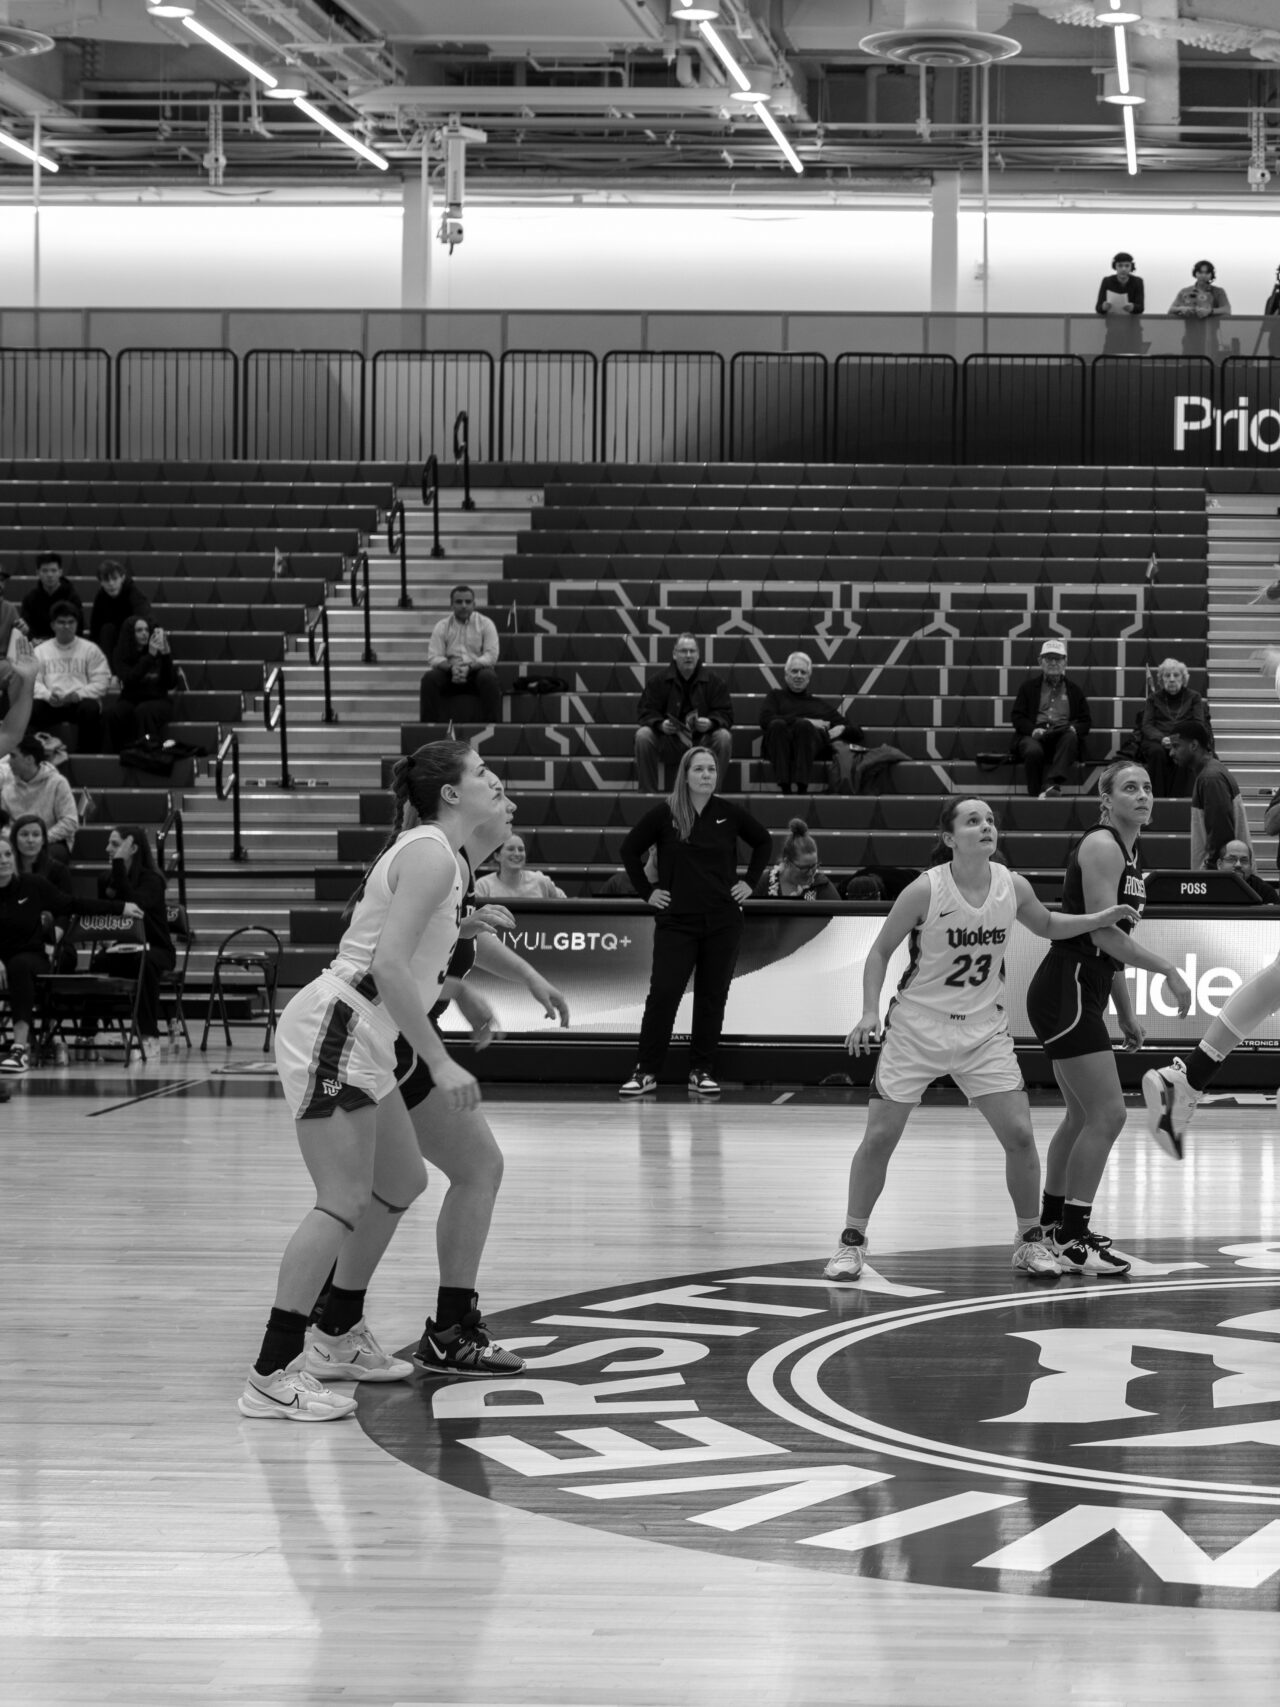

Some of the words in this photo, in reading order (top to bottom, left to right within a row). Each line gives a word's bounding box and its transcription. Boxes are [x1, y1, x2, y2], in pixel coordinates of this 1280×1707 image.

[1180, 882, 1207, 895] POSS
[945, 925, 1007, 949] Violets
[943, 953, 993, 988] 23
[1108, 952, 1243, 1017] ride
[949, 1013, 966, 1021] NYU
